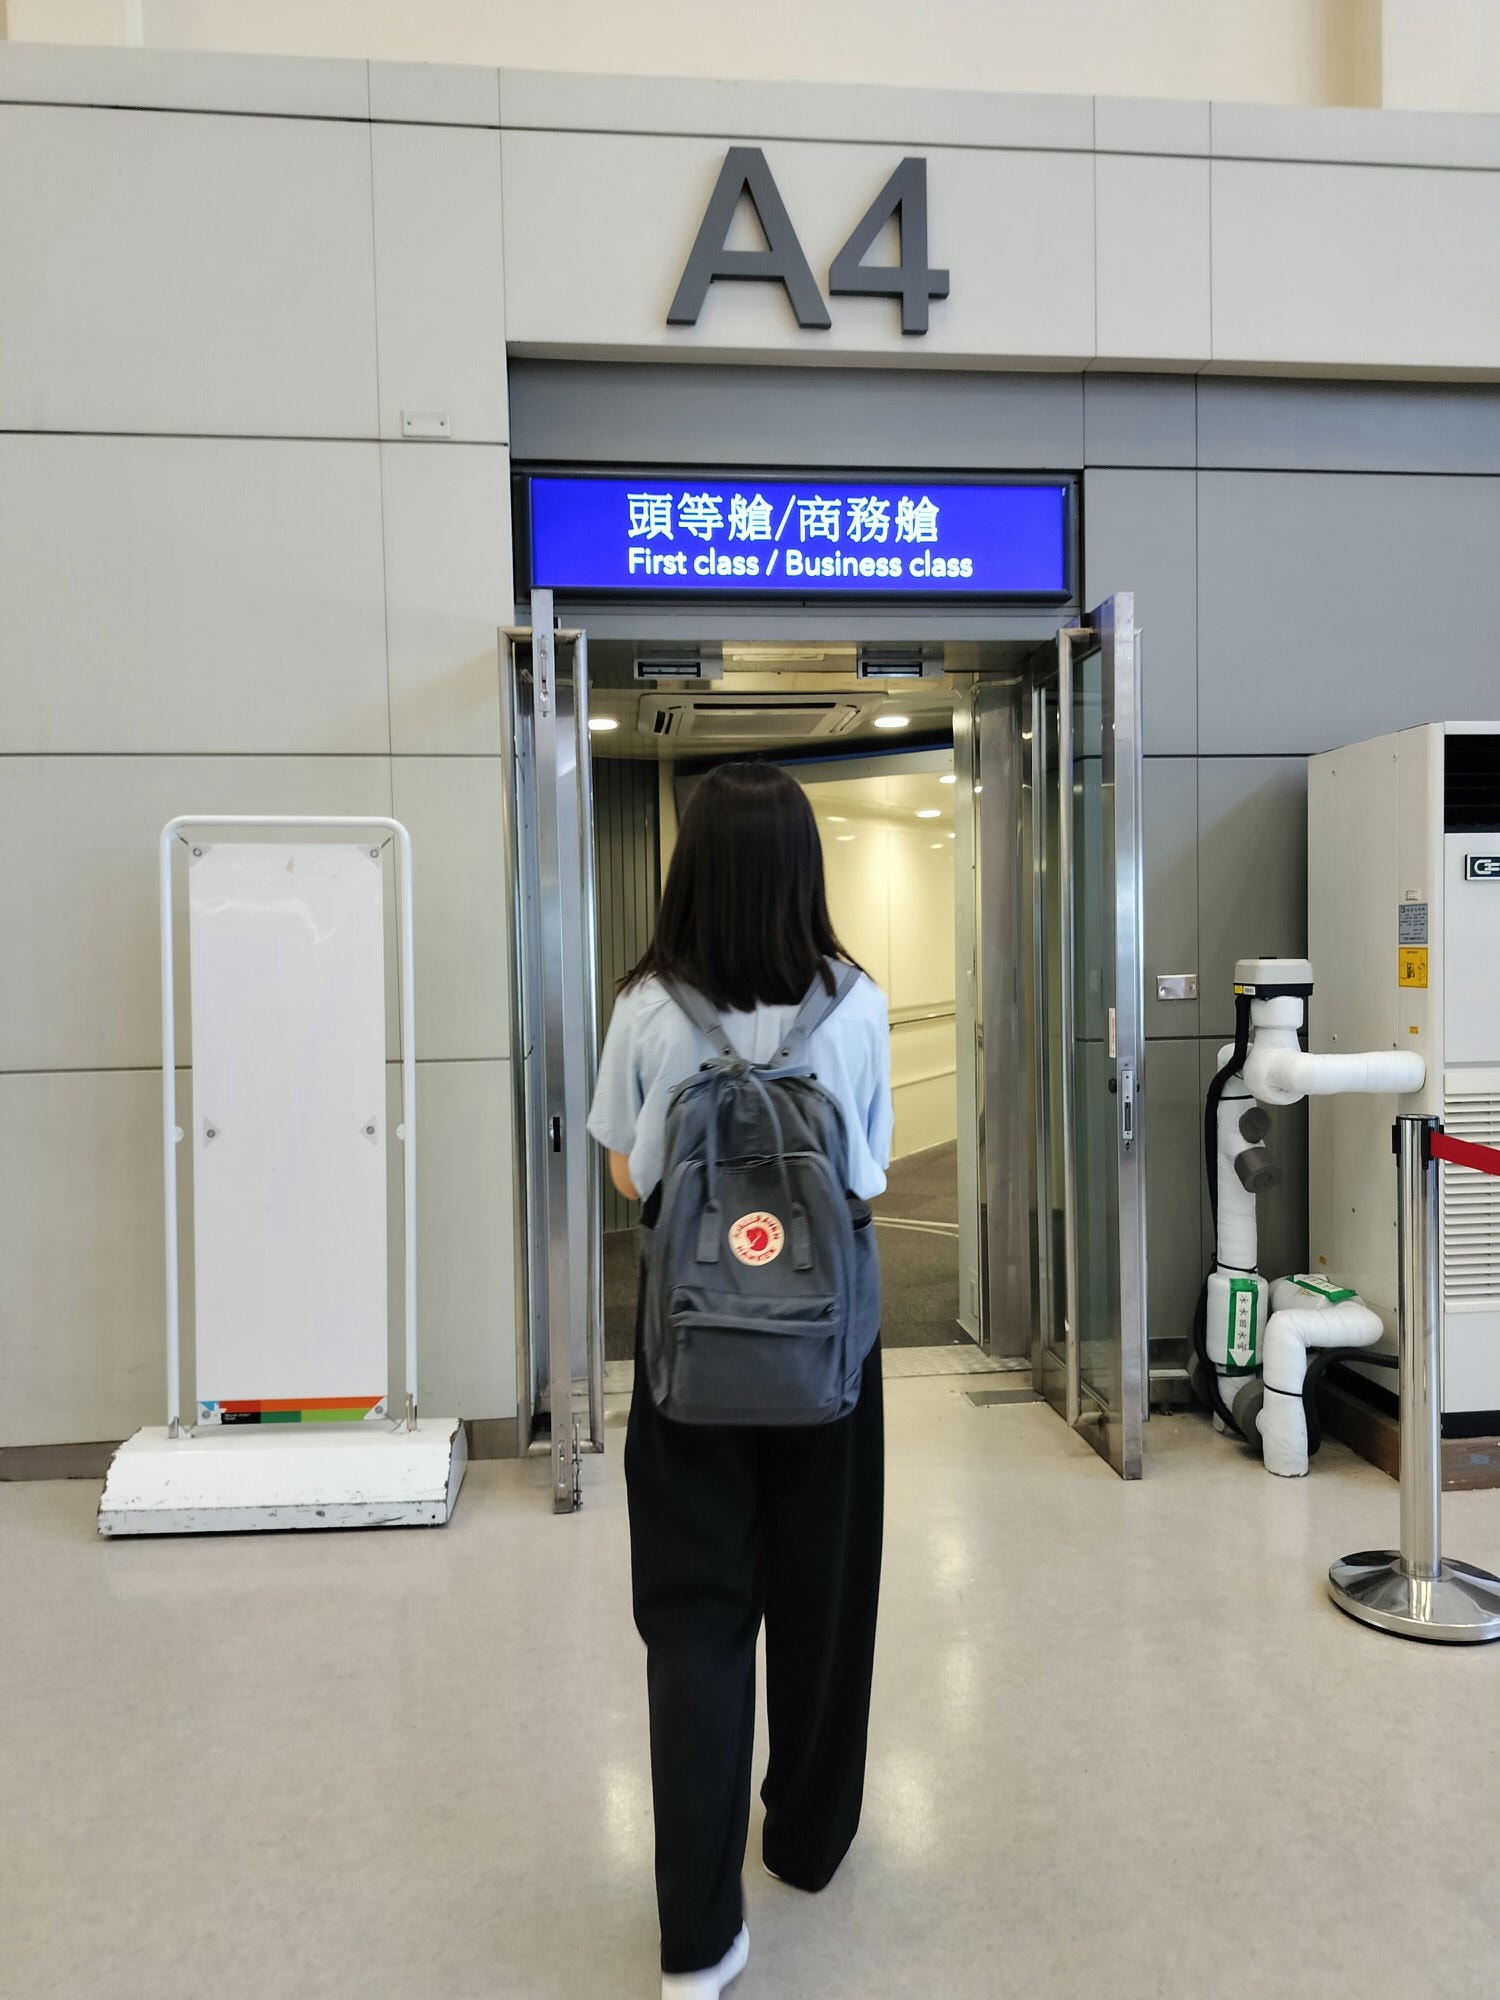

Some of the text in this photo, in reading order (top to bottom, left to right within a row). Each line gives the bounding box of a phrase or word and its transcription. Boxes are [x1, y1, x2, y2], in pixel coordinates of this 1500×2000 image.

[666, 146, 949, 336] A4
[627, 492, 939, 543] 頭等艙/商務艙
[629, 547, 973, 577] First class / Business class
